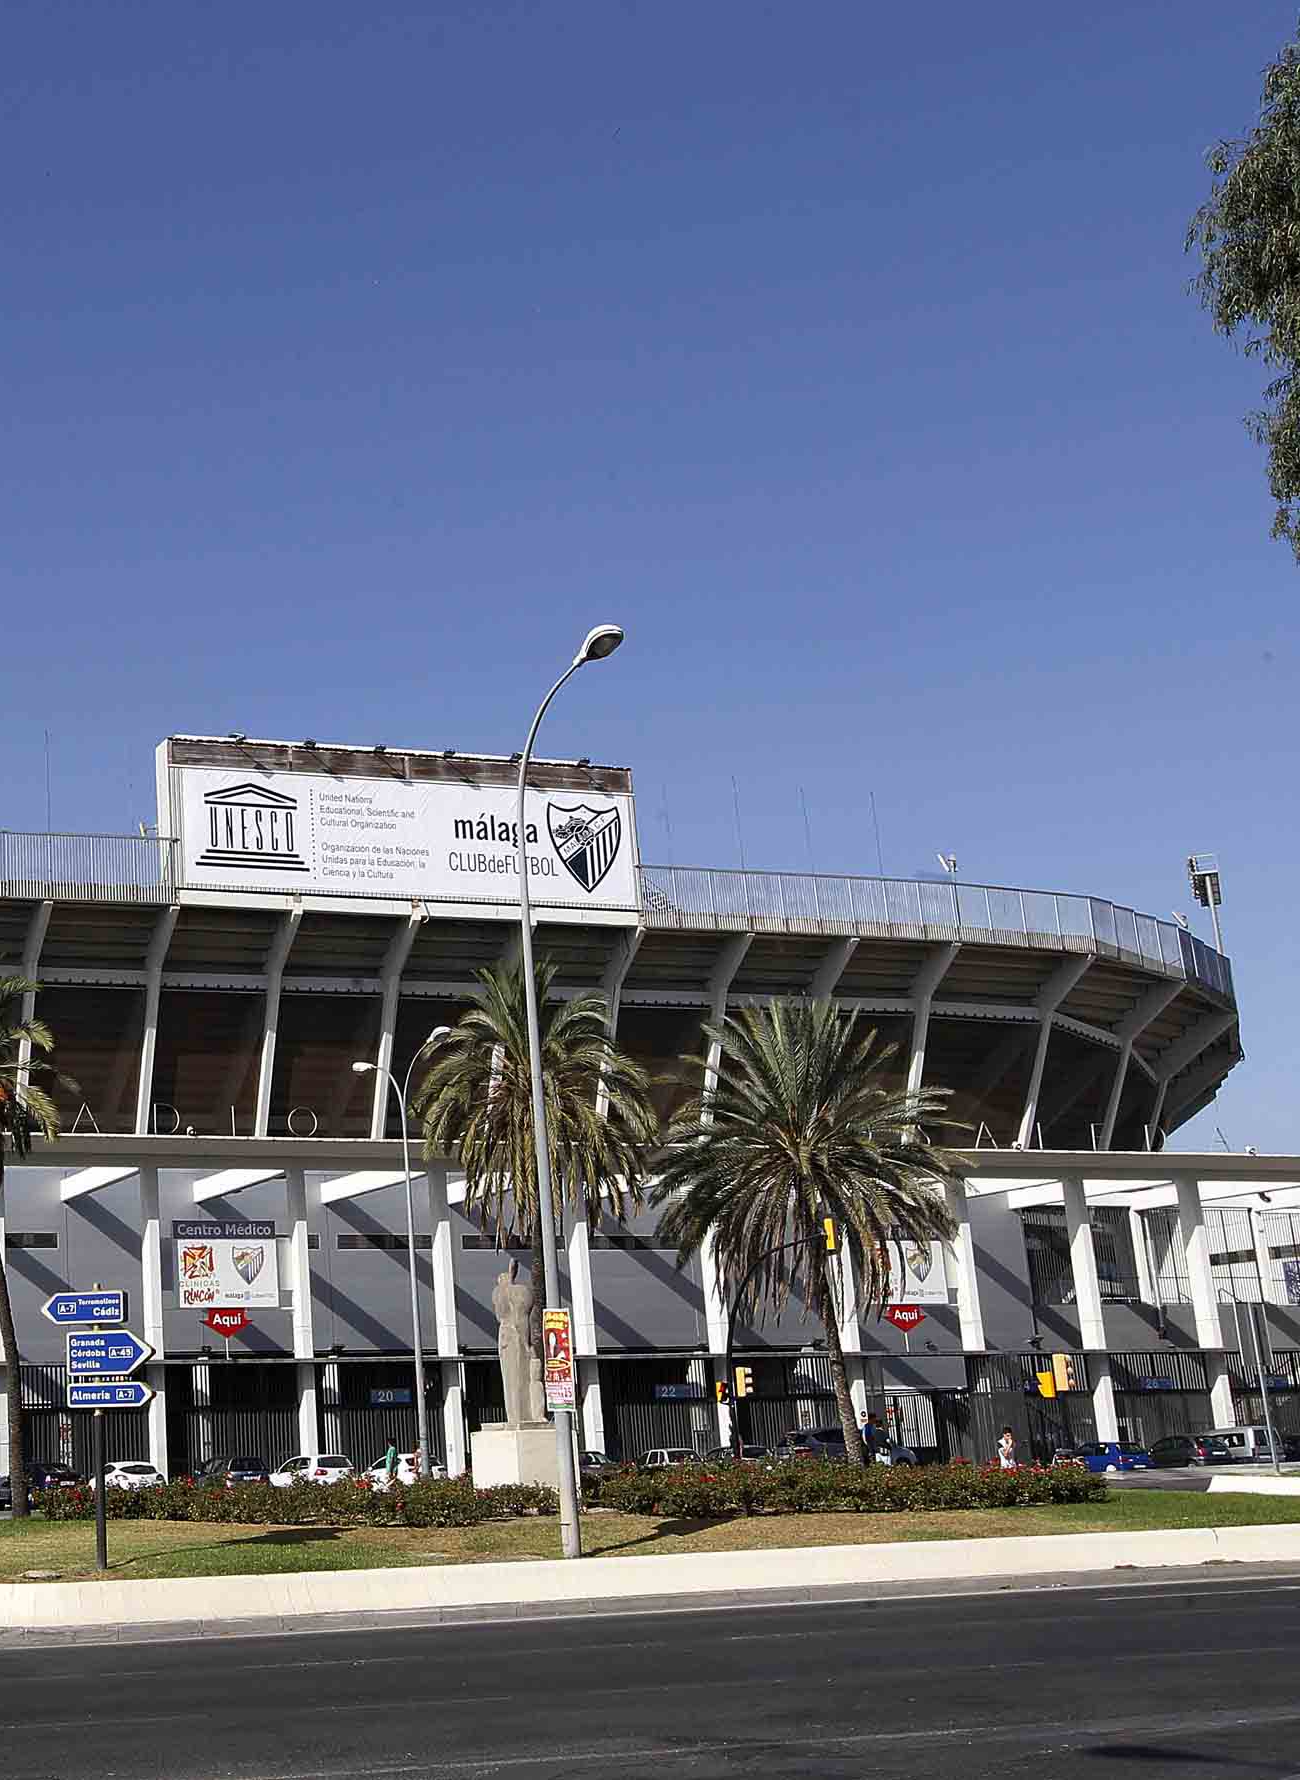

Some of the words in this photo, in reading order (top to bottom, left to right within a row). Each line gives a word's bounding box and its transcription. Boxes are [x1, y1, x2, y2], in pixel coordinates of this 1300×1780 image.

[210, 806, 294, 852] UNESCO
[320, 817, 348, 827] Cultural
[350, 819, 397, 830] Organization
[371, 845, 381, 854] de
[382, 846, 394, 855] las
[395, 846, 430, 857] Naciones
[322, 855, 348, 865] Unidas
[349, 857, 367, 867] para
[368, 857, 375, 866] la
[418, 860, 426, 869] la
[352, 870, 357, 879] y
[358, 870, 366, 878] la
[367, 869, 394, 880] Cultura
[177, 1223, 221, 1236] Centro
[225, 1223, 272, 1236] Médico
[59, 1304, 75, 1313] A-7
[92, 1306, 120, 1316] Cádiz
[212, 1312, 242, 1327] Aquí
[70, 1339, 106, 1347] Granada
[70, 1348, 106, 1358] Córdoba
[110, 1349, 132, 1357] A-45
[70, 1360, 101, 1369] Sevilla
[71, 1390, 111, 1401] Almería
[118, 1391, 134, 1399] A-7
[378, 1390, 394, 1402] 20
[660, 1385, 676, 1398] 22
